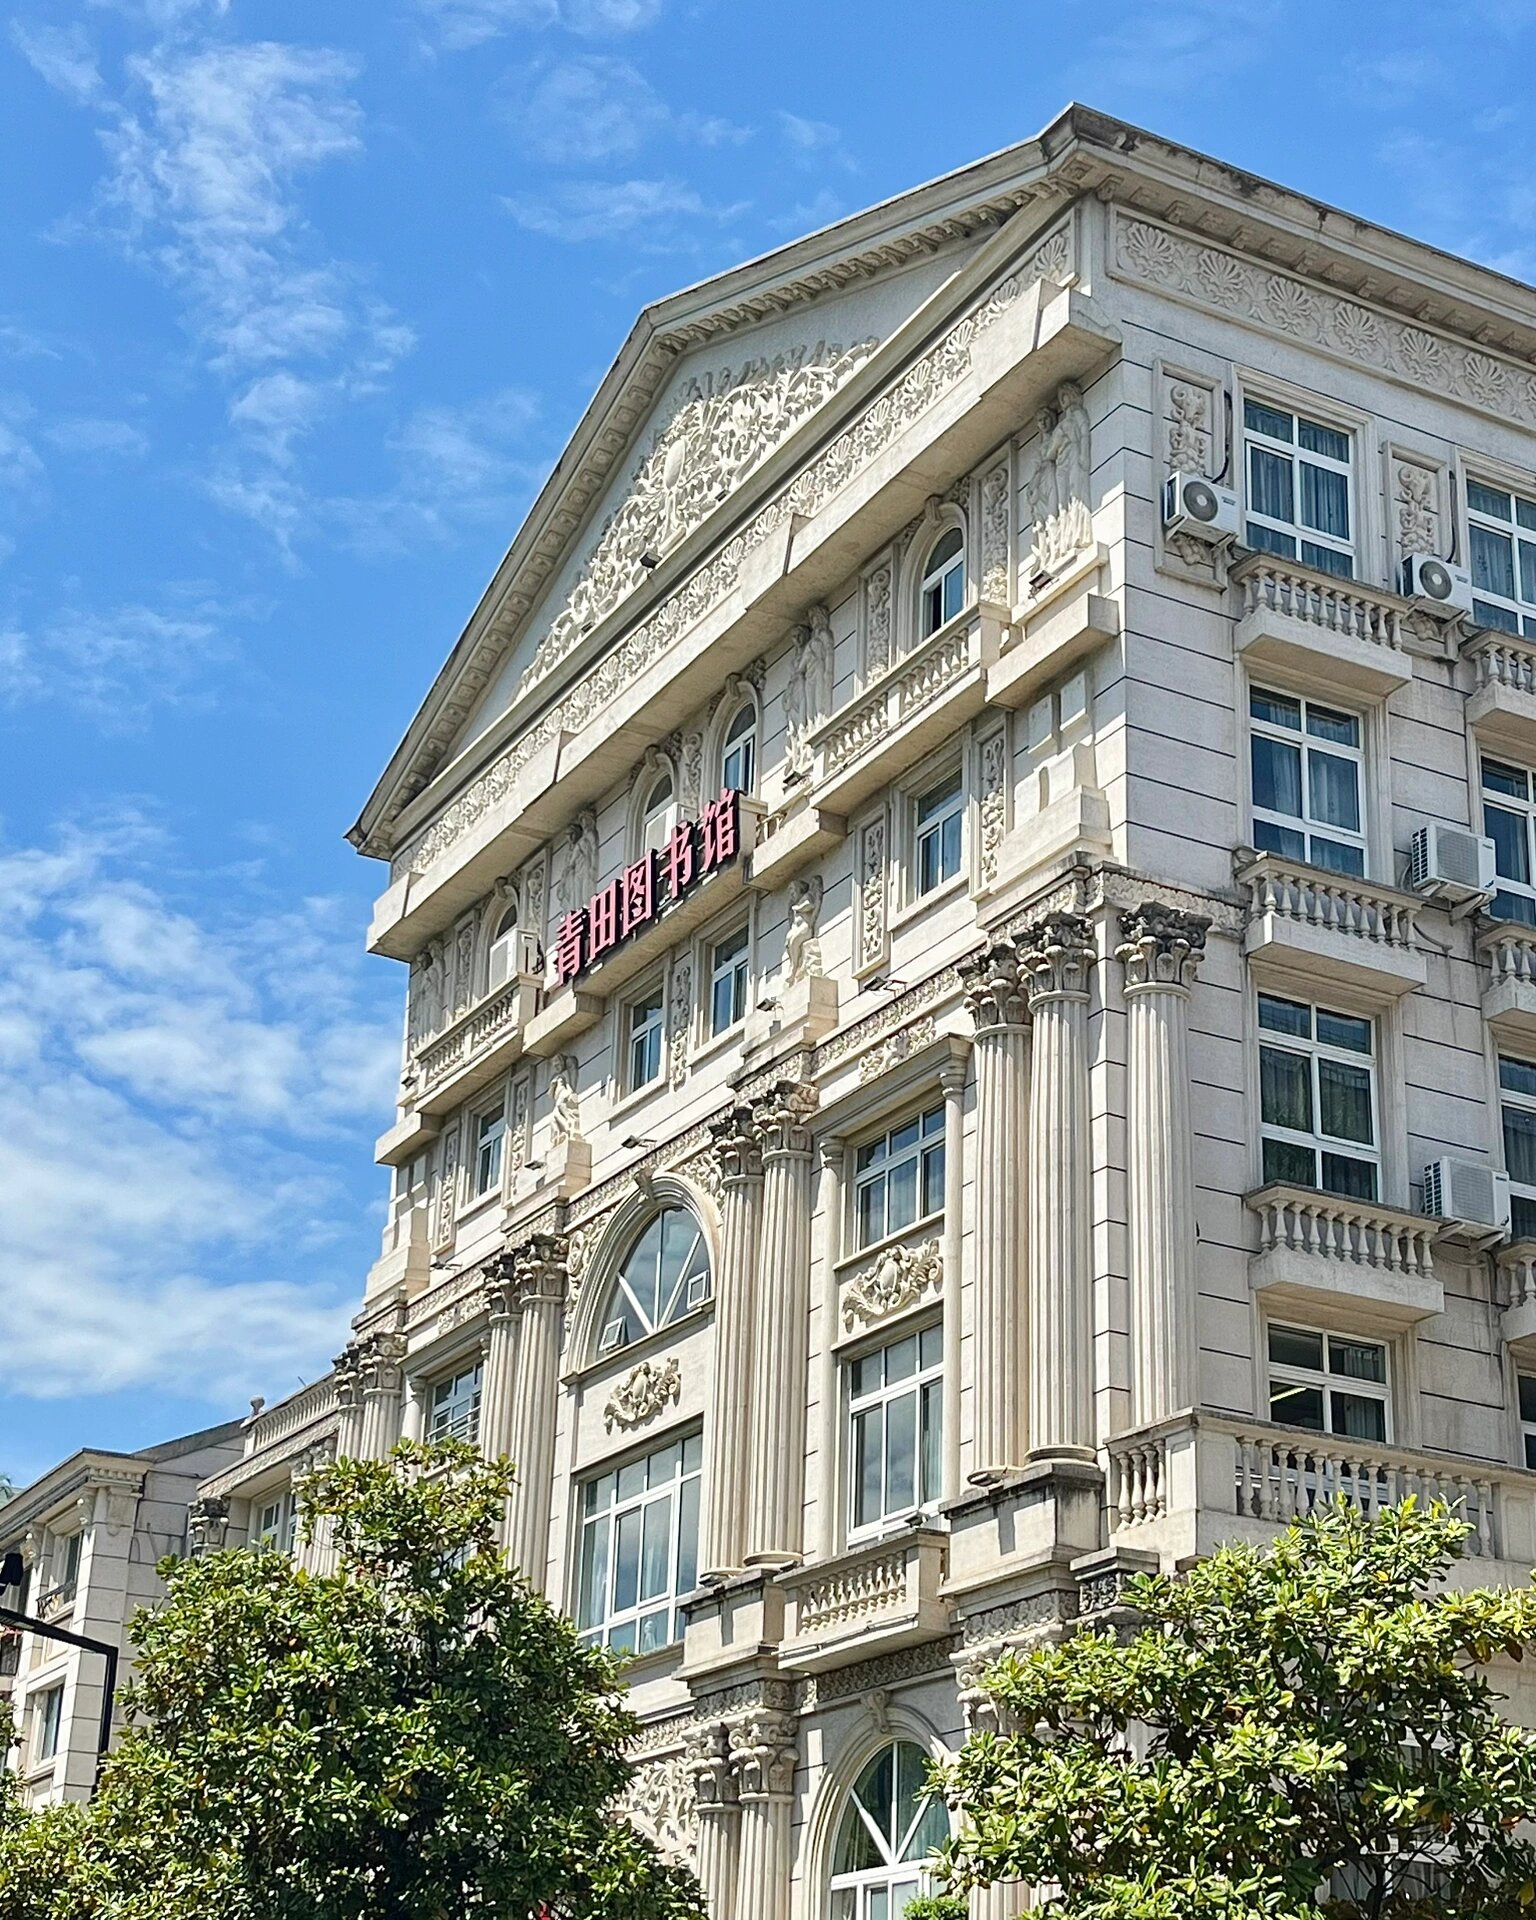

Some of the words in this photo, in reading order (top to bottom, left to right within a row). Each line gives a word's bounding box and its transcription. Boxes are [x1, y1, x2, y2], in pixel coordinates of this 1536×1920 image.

[555, 788, 738, 985] 青田图书馆
